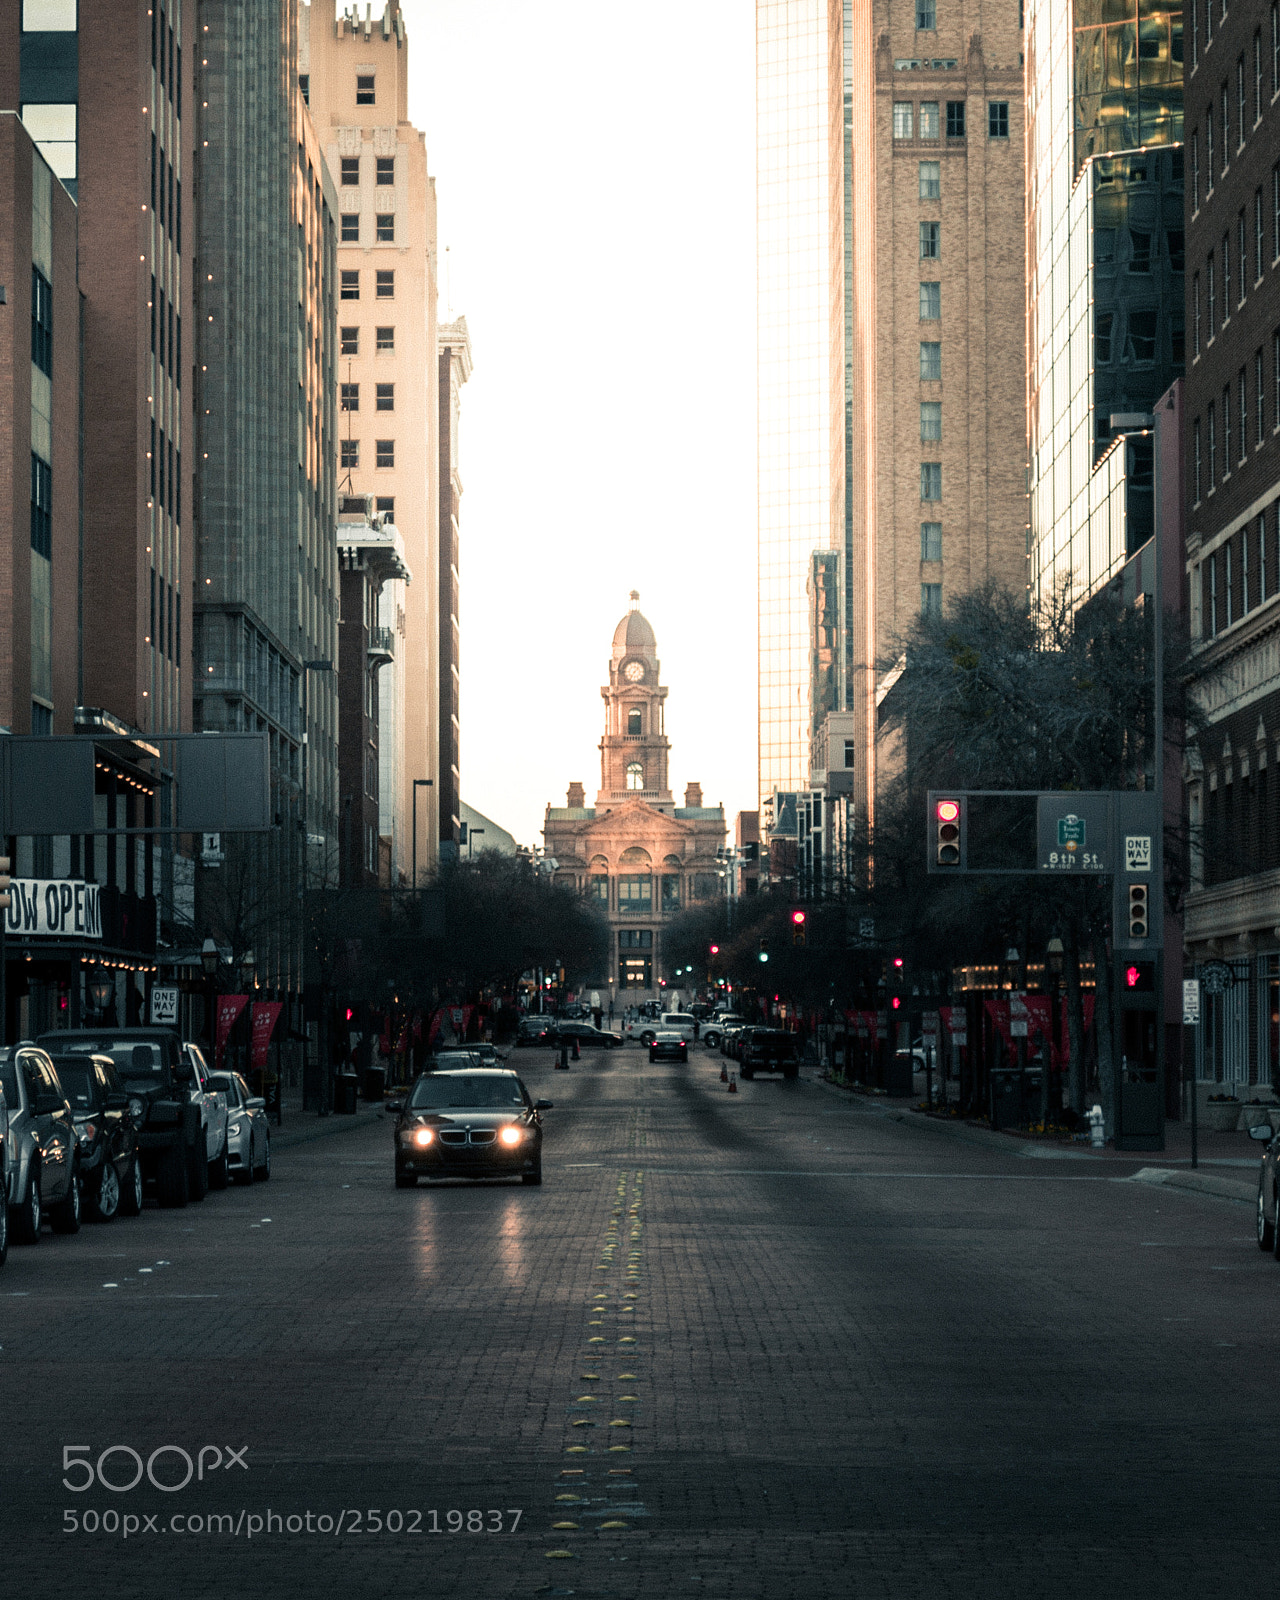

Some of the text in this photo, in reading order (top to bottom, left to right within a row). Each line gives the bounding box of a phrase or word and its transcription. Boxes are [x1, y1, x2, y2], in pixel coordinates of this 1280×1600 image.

[1127, 840, 1149, 849] ONE
[1049, 852, 1098, 864] 8th St
[1127, 850, 1149, 859] WAY
[7, 882, 38, 930] OW
[154, 992, 175, 1001] ONE
[154, 1002, 175, 1011] WAY
